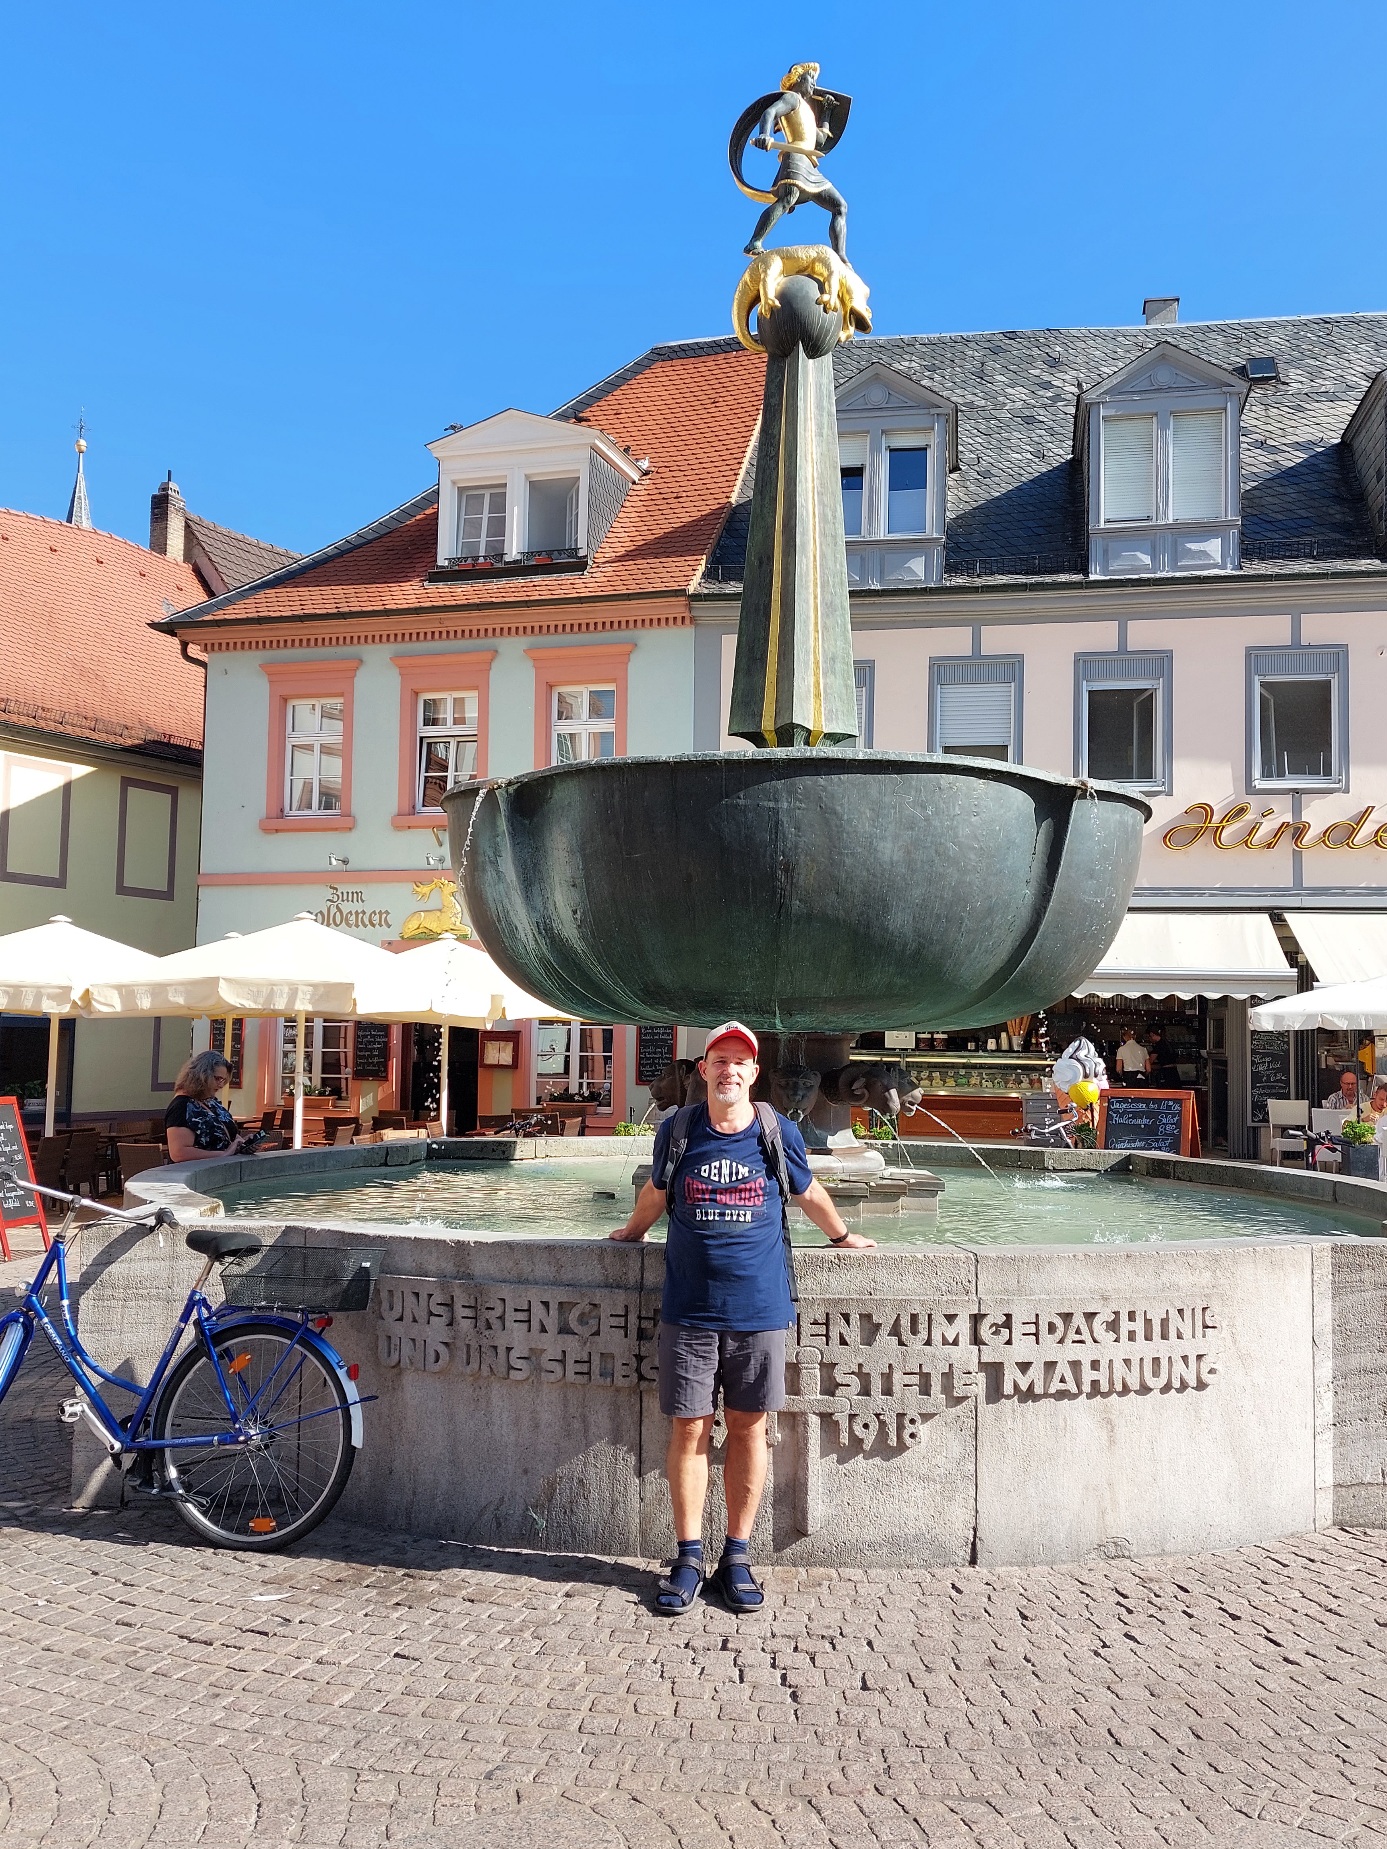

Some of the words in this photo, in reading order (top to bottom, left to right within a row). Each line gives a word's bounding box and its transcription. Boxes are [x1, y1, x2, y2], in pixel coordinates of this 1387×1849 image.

[326, 884, 366, 904] Zum
[307, 903, 392, 929] oldenen
[1145, 1137, 1173, 1148] Salat
[700, 1159, 750, 1184] DENIM
[717, 1177, 765, 1207] GOODS
[696, 1209, 720, 1221] BLUE
[379, 1288, 553, 1334] UNSEREN
[567, 1301, 660, 1344] GEF
[869, 1312, 971, 1347] ZUM
[378, 1335, 451, 1374] UND
[464, 1344, 532, 1381] UNS
[540, 1350, 660, 1389] SELBS
[1003, 1353, 1221, 1396] MAHNUNG
[832, 1412, 923, 1451] 1918
